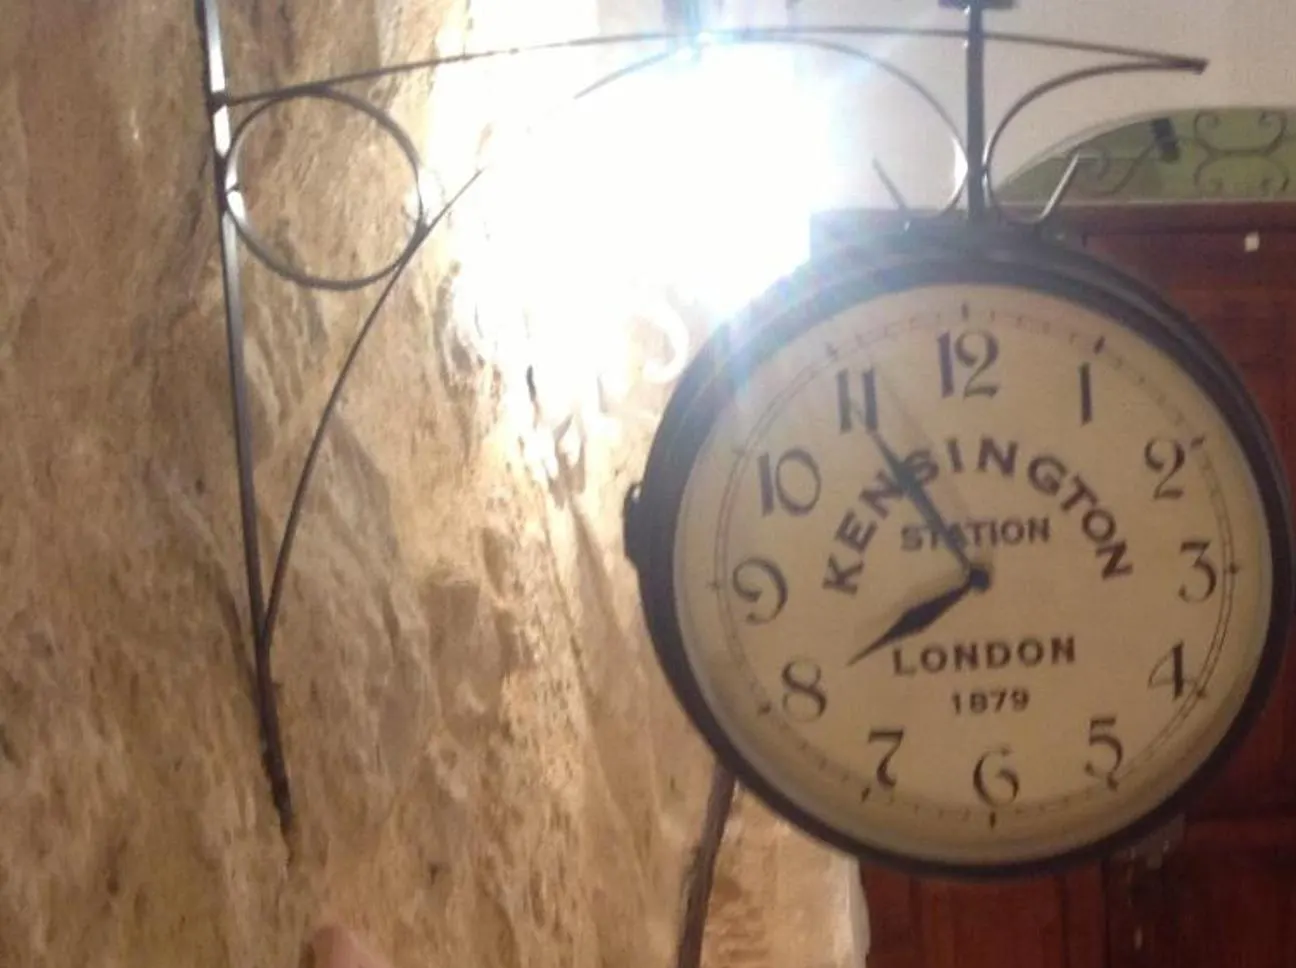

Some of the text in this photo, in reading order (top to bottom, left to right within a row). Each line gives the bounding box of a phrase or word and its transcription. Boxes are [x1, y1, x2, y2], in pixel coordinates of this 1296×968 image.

[937, 329, 999, 400] 12
[1077, 361, 1093, 426] 1
[838, 367, 879, 434] 11
[757, 448, 821, 516] 10
[1144, 438, 1186, 500] 2
[822, 437, 1133, 596] KENSINGTON
[731, 557, 787, 624] 9
[1179, 540, 1217, 603] 3
[781, 657, 828, 721] 8
[892, 637, 1076, 677] LONDON
[1147, 640, 1195, 700] 4
[951, 688, 1030, 715] 1879
[867, 728, 905, 789] 7
[972, 748, 1020, 807] 6
[1083, 715, 1123, 779] 5
